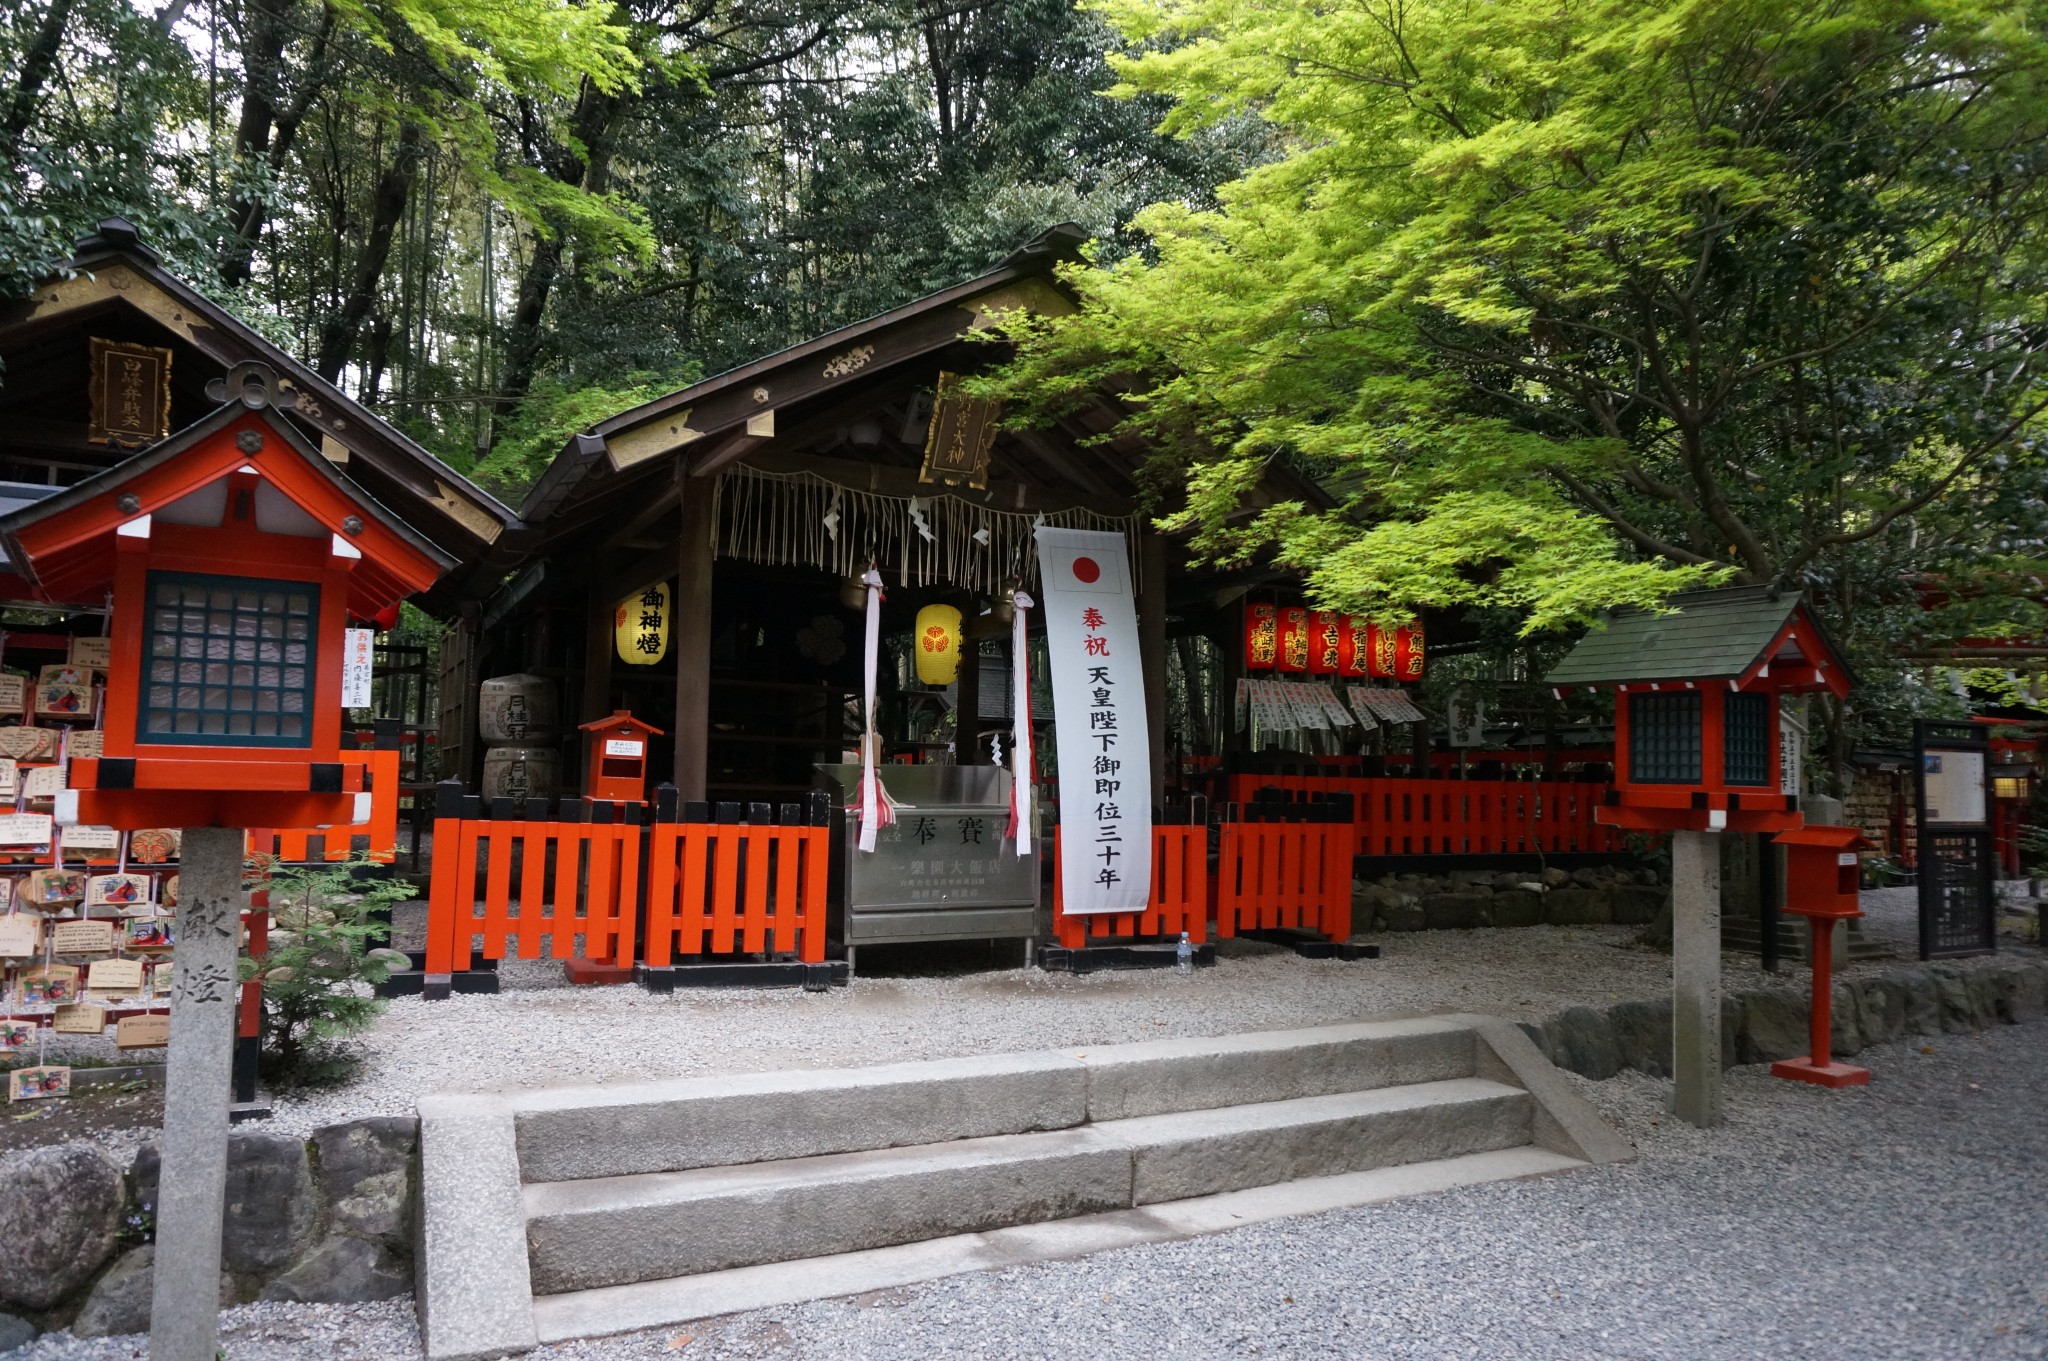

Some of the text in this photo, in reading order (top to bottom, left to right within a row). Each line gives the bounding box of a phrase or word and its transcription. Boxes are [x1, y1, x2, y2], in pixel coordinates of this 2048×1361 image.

[637, 587, 664, 655] 御神燈
[1323, 625, 1338, 668] 吉兆
[1408, 633, 1423, 674] 熊彦
[507, 695, 529, 740] 月桂冠
[1081, 607, 1123, 891] 奉祝 天皇陛下御即位三十年
[912, 816, 984, 846] 奉賽
